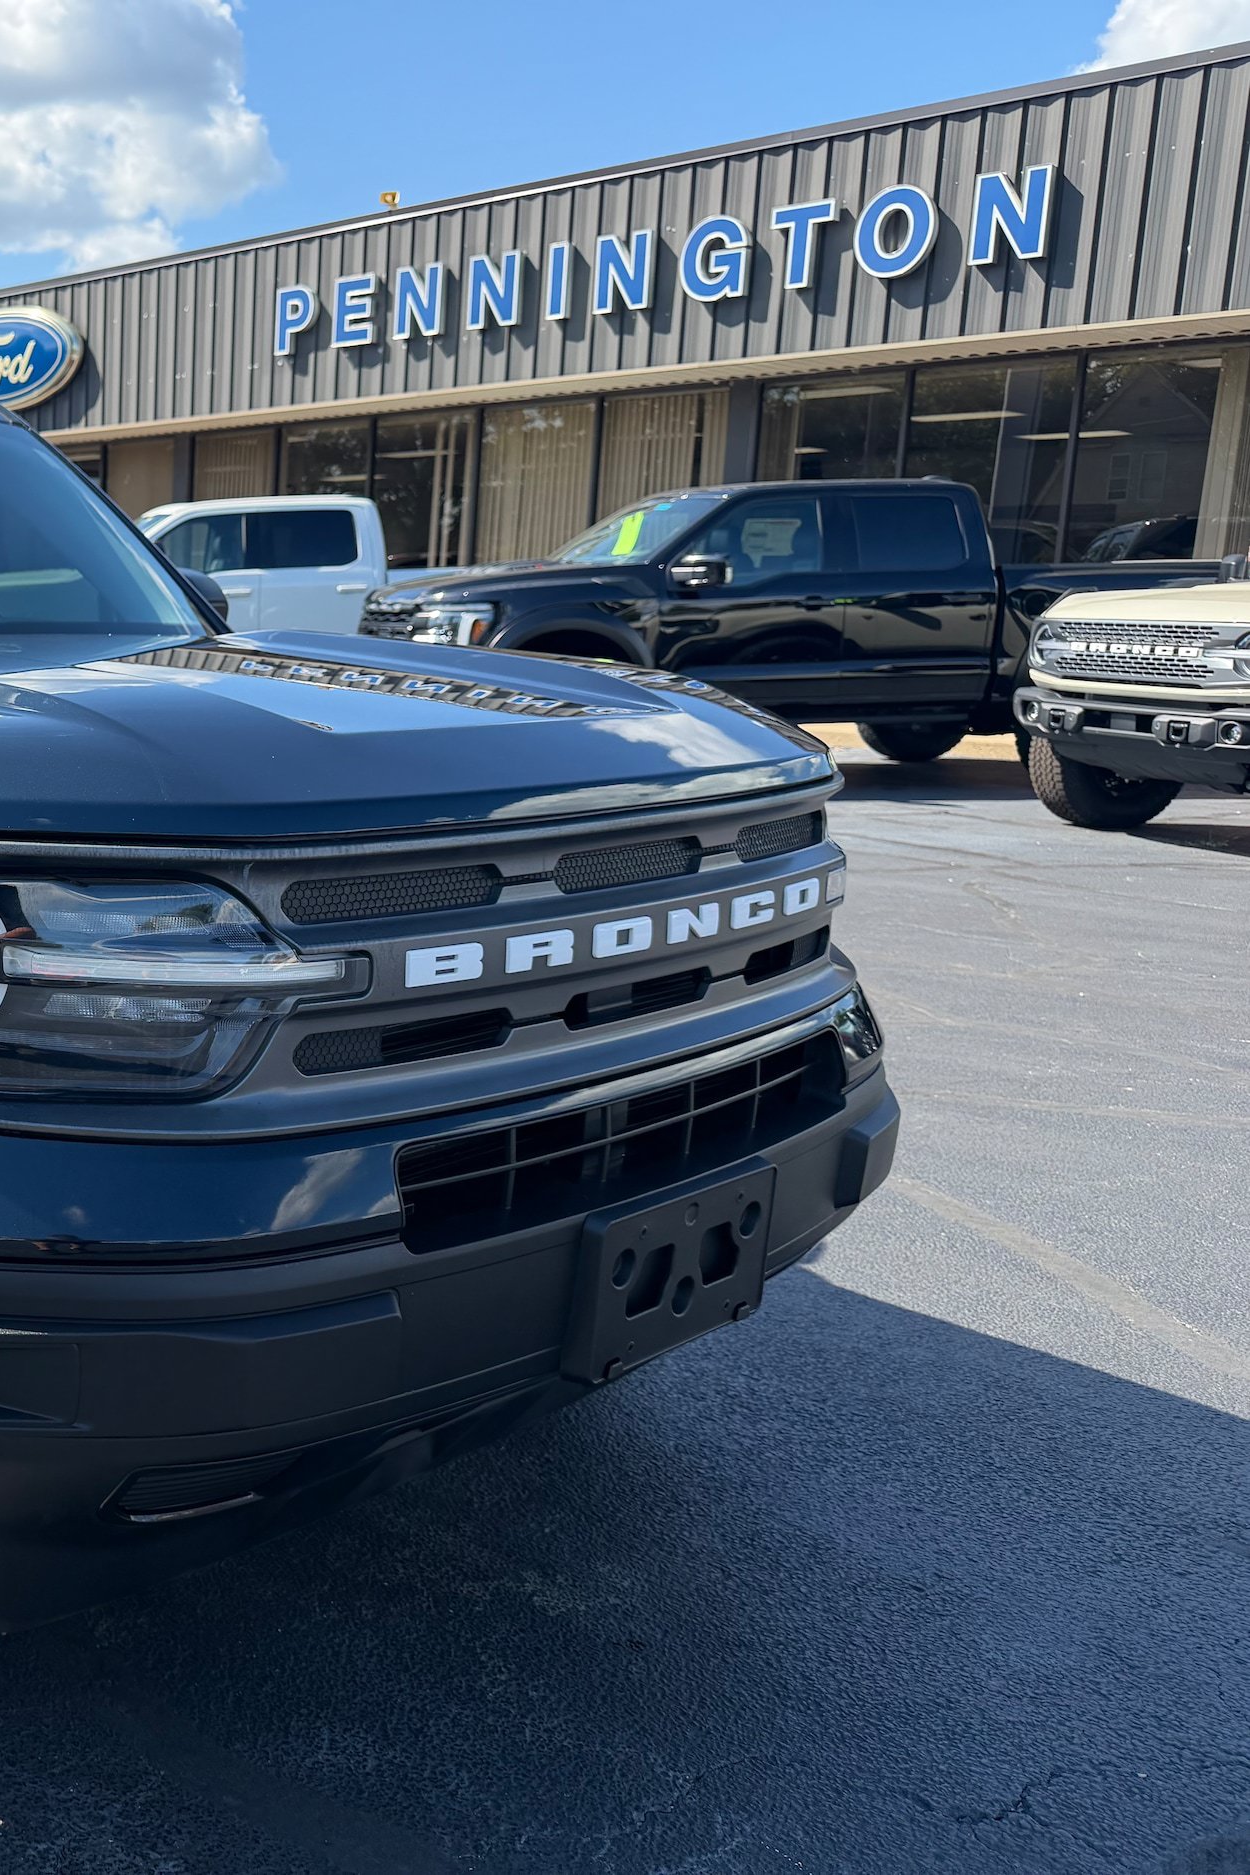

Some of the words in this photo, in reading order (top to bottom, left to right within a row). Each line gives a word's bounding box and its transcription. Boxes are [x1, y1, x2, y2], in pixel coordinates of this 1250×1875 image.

[273, 163, 1057, 357] PENNINGTON
[1070, 641, 1200, 658] BRONCO
[404, 877, 821, 988] BRONCO
